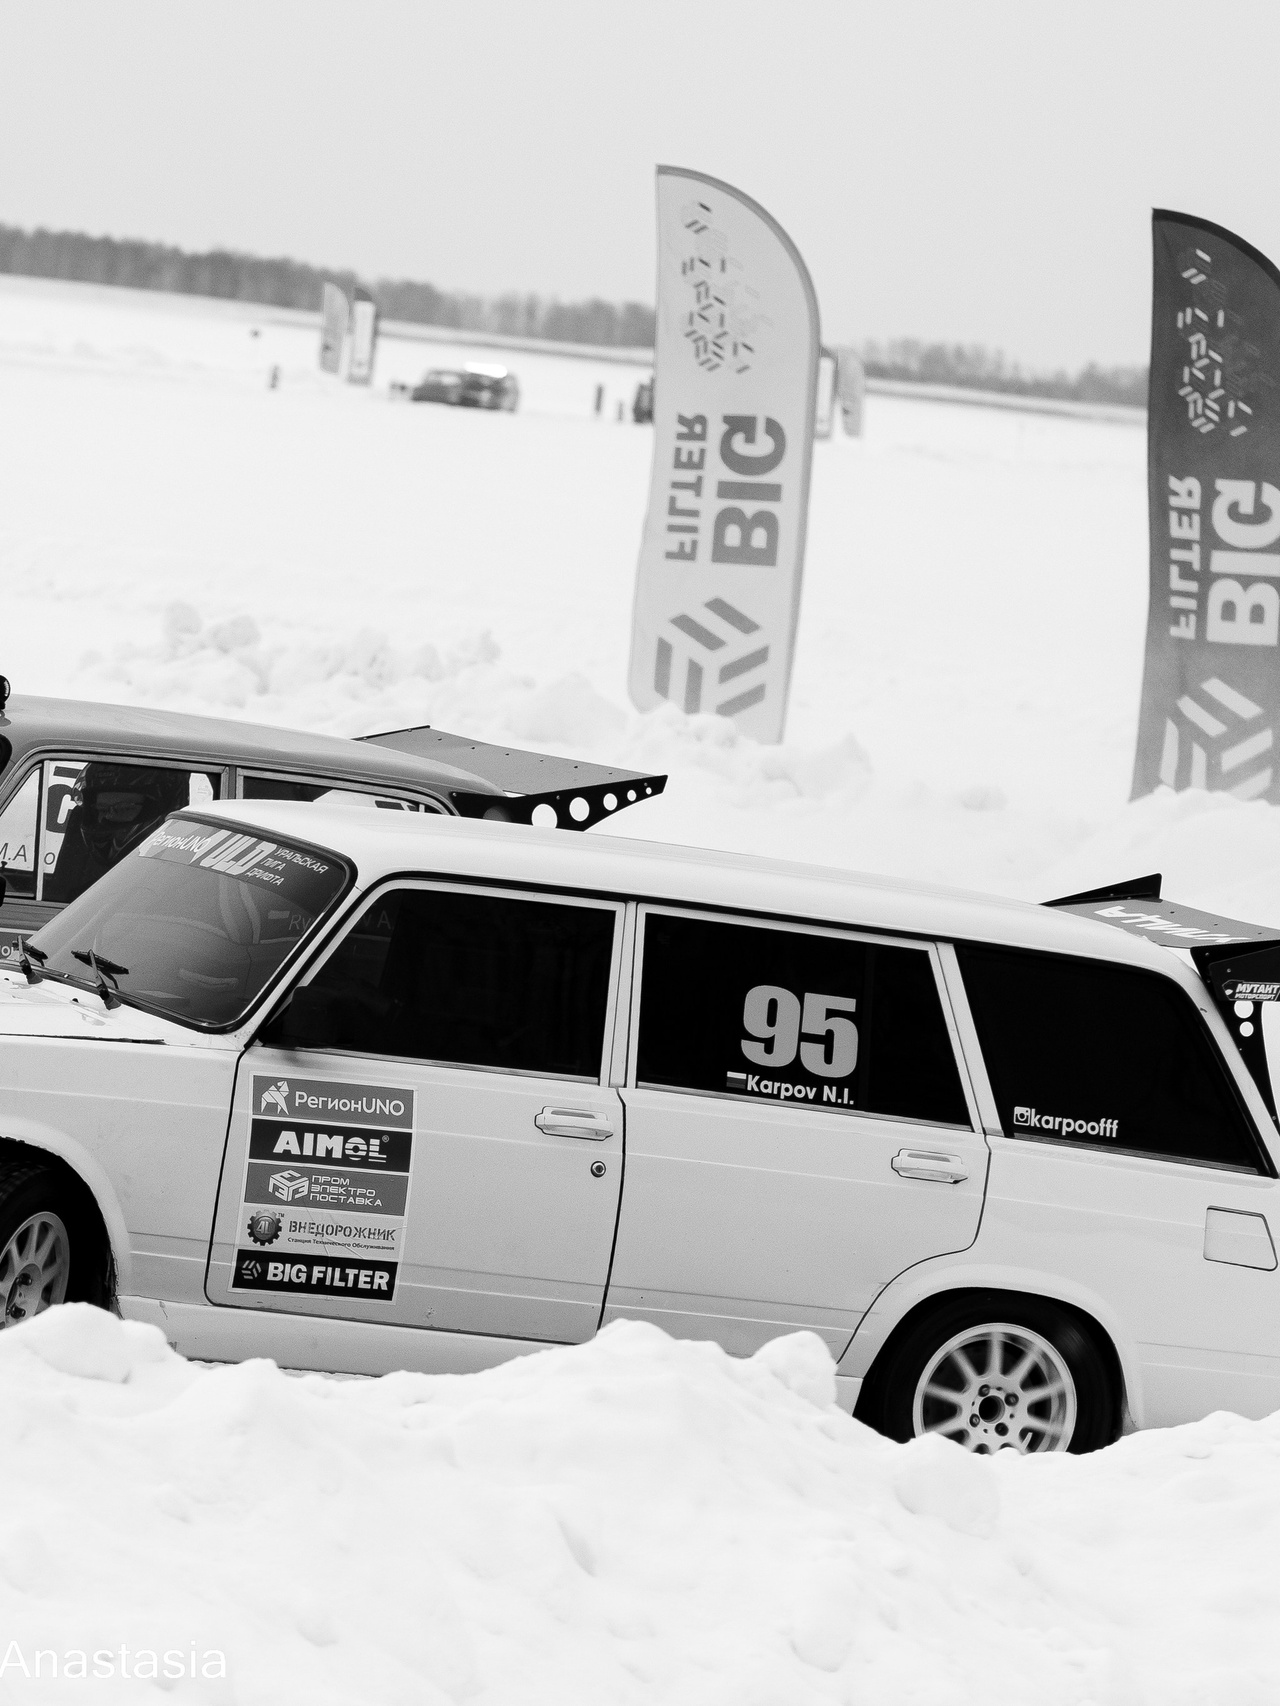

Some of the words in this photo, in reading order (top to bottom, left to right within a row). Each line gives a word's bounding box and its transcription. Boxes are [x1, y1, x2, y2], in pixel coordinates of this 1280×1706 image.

[275, 847, 329, 875] УРАЛЬСКАЯ
[245, 867, 285, 886] ДРИФТА
[1235, 983, 1280, 994] МУТАНТ
[741, 984, 859, 1078] 95
[747, 1074, 817, 1099] Karpov
[823, 1085, 855, 1105] N.I.
[295, 1091, 405, 1117] РегионUNO
[1030, 1108, 1119, 1138] karpoofff
[311, 1175, 350, 1186] ПРОМ
[311, 1184, 376, 1197] ЭЛЕКТРО
[310, 1193, 383, 1207] ПОСТАВКА
[289, 1220, 396, 1241] ВНЕДОРОЖНИК
[267, 1262, 307, 1284] BIG
[311, 1266, 390, 1291] FILTER
